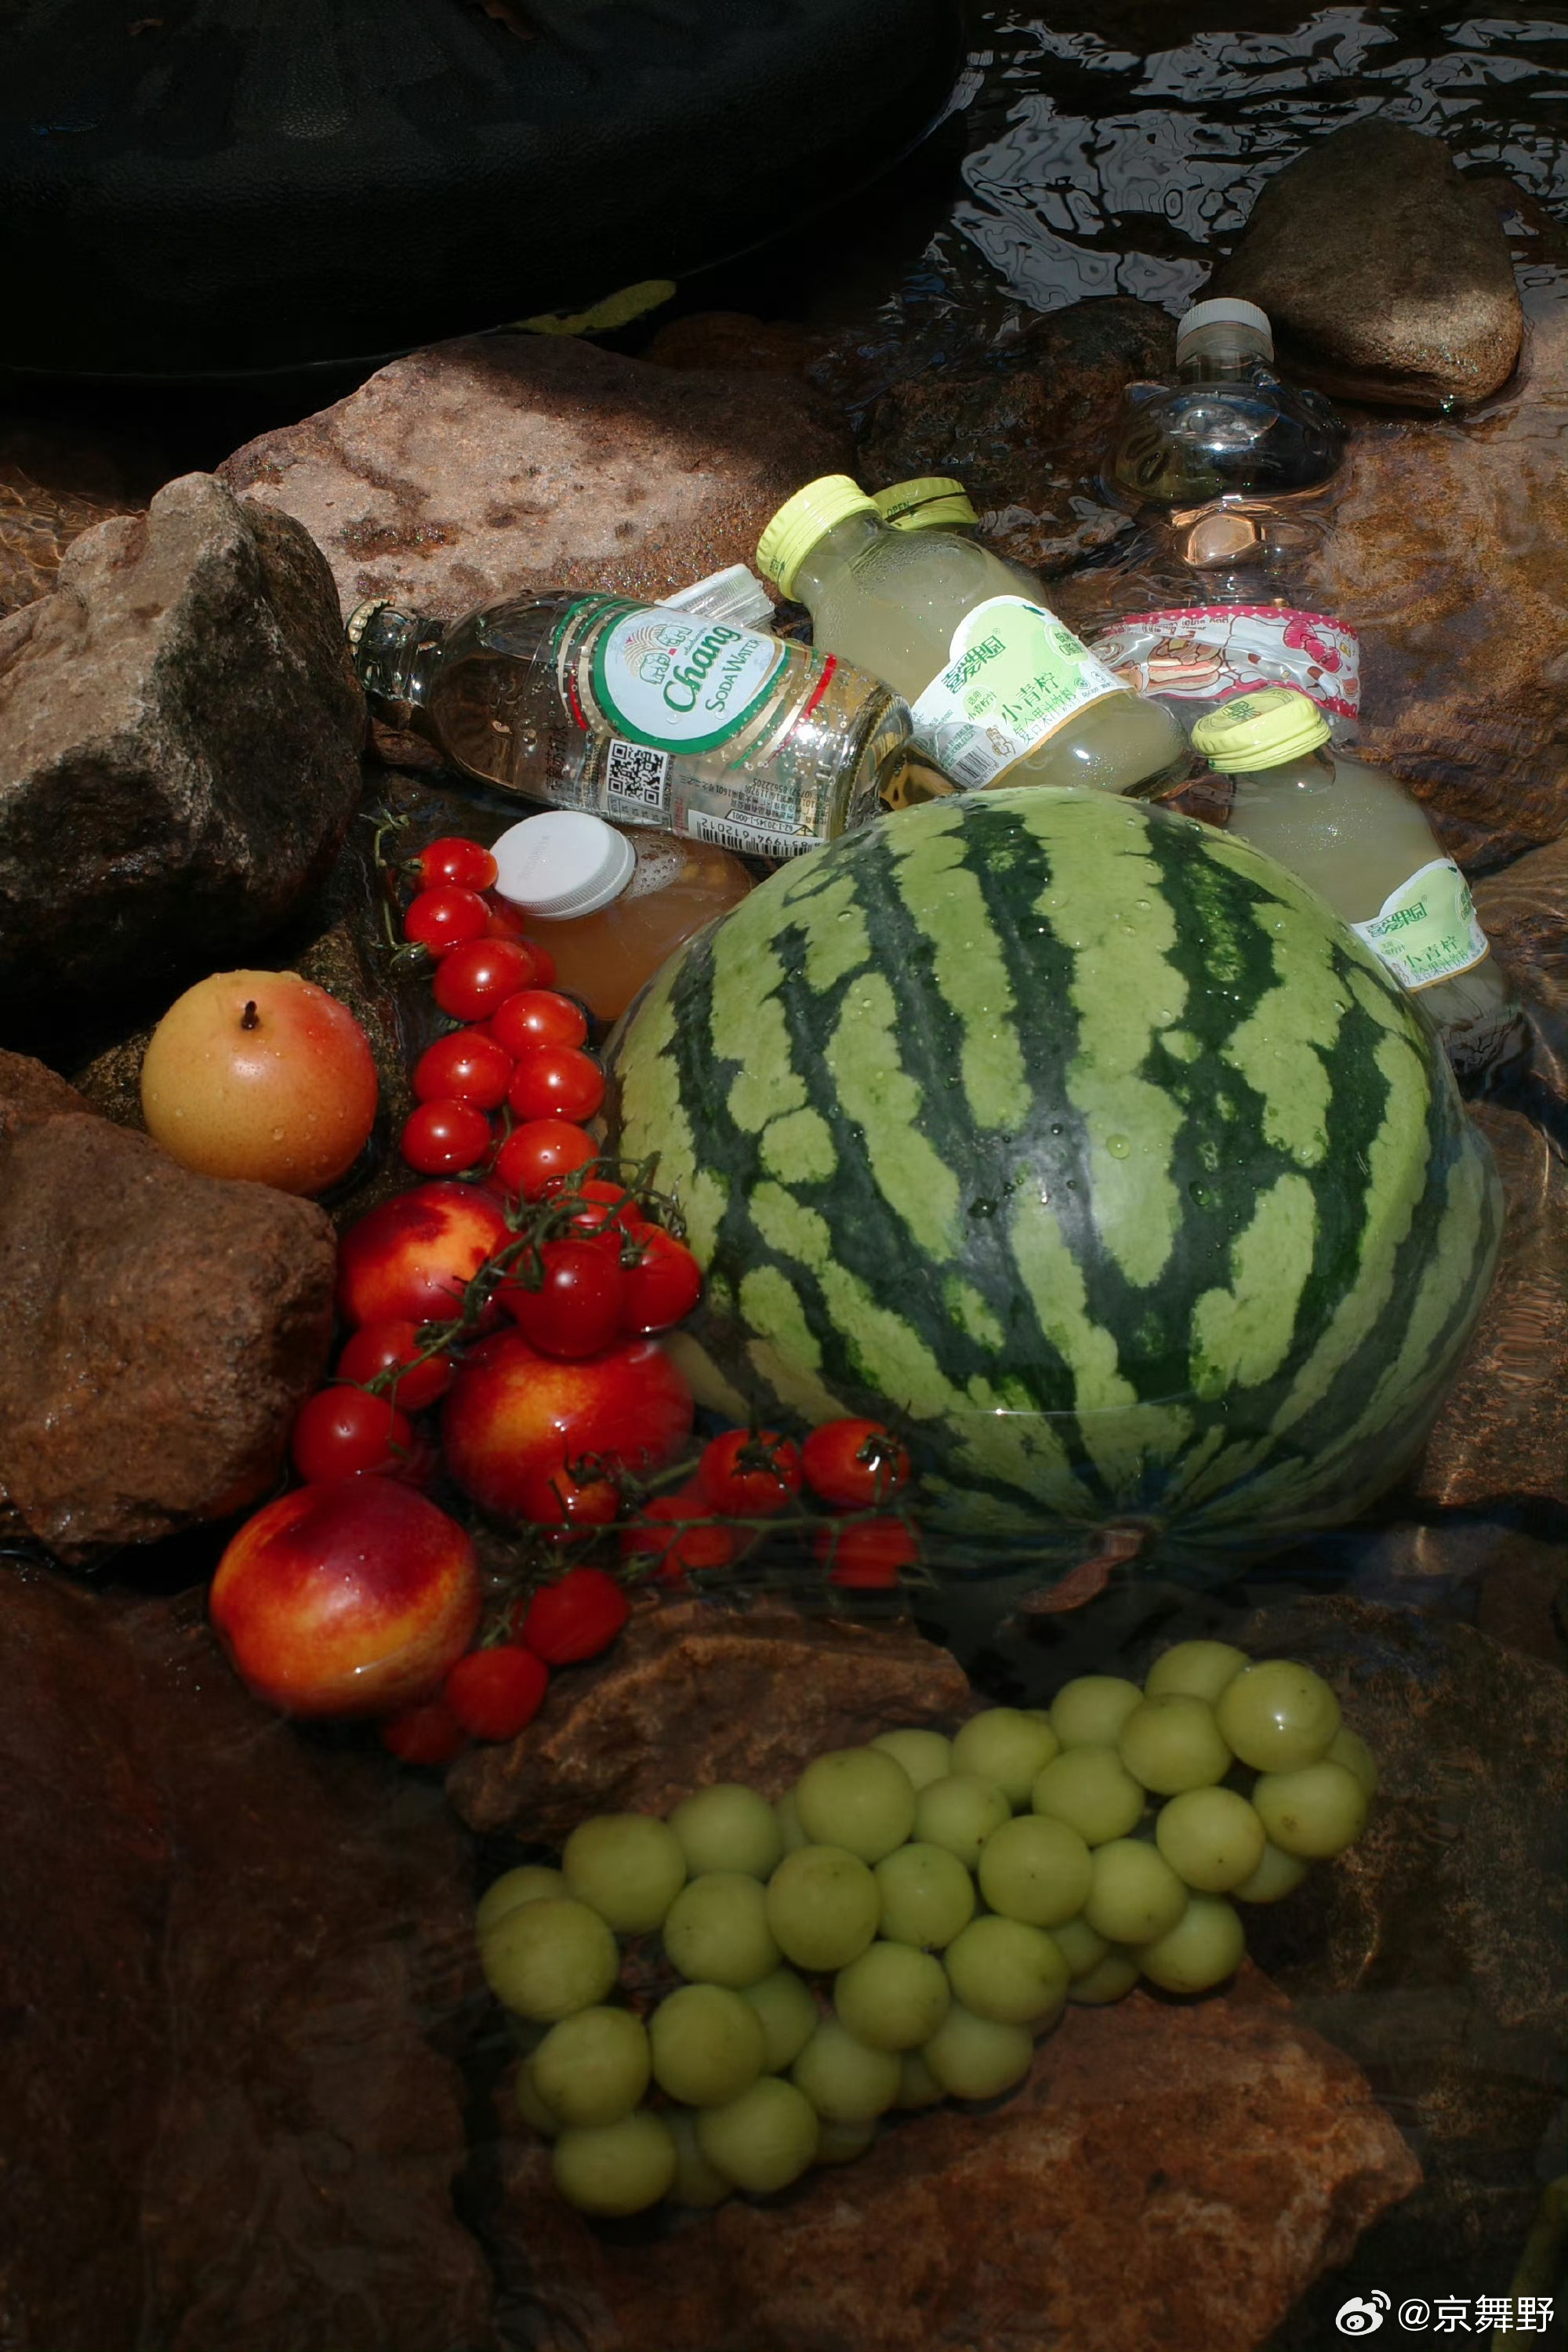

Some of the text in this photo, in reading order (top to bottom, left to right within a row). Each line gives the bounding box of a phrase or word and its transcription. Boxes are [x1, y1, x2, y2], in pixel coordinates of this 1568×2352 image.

[887, 501, 909, 517] OPEN
[663, 626, 742, 713] Chang
[941, 634, 1006, 695] 喜爱果园
[705, 674, 739, 713] SODA
[1001, 672, 1059, 725] 小青柠
[1013, 688, 1080, 745] 复合果汁饮料
[701, 818, 750, 838] 612012
